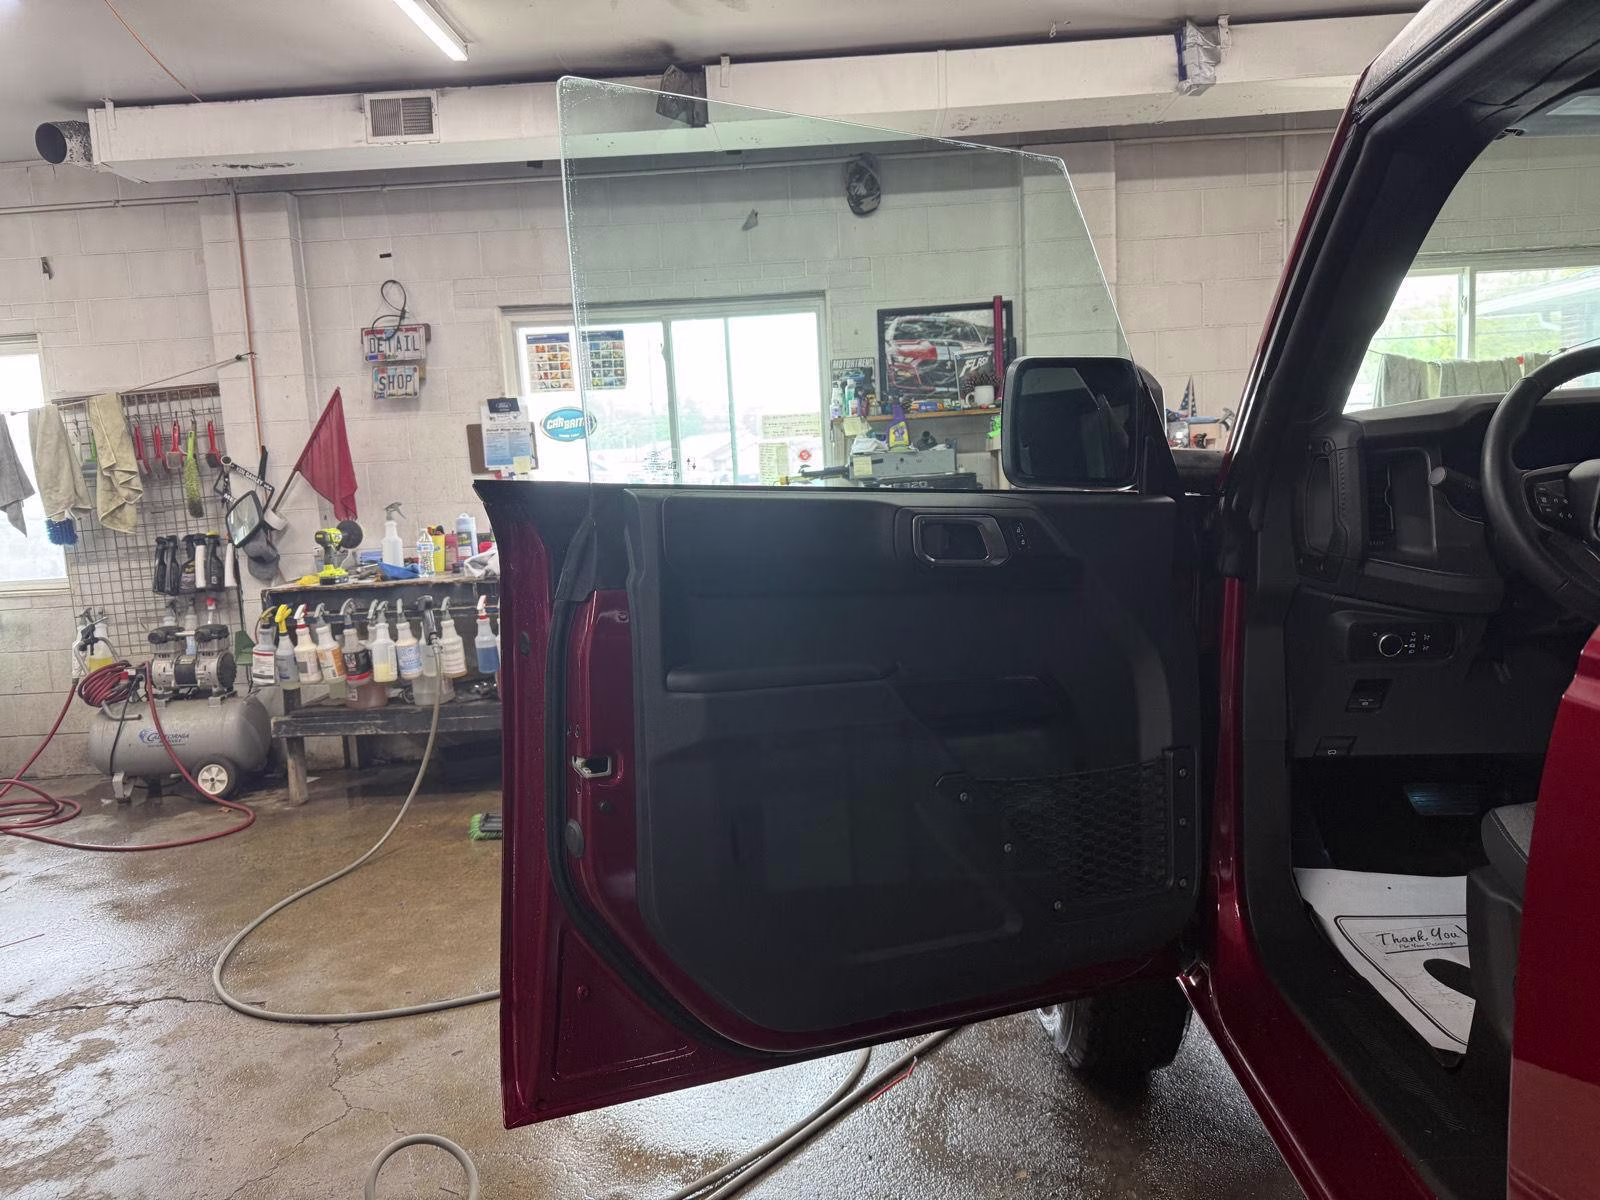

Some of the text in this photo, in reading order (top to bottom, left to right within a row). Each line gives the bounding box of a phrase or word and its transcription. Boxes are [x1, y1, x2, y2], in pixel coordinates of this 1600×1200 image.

[369, 335, 420, 353] DETAIL
[379, 374, 413, 391] SHOP
[147, 732, 190, 742] CALFORNIA
[1375, 927, 1460, 946] Thank You
